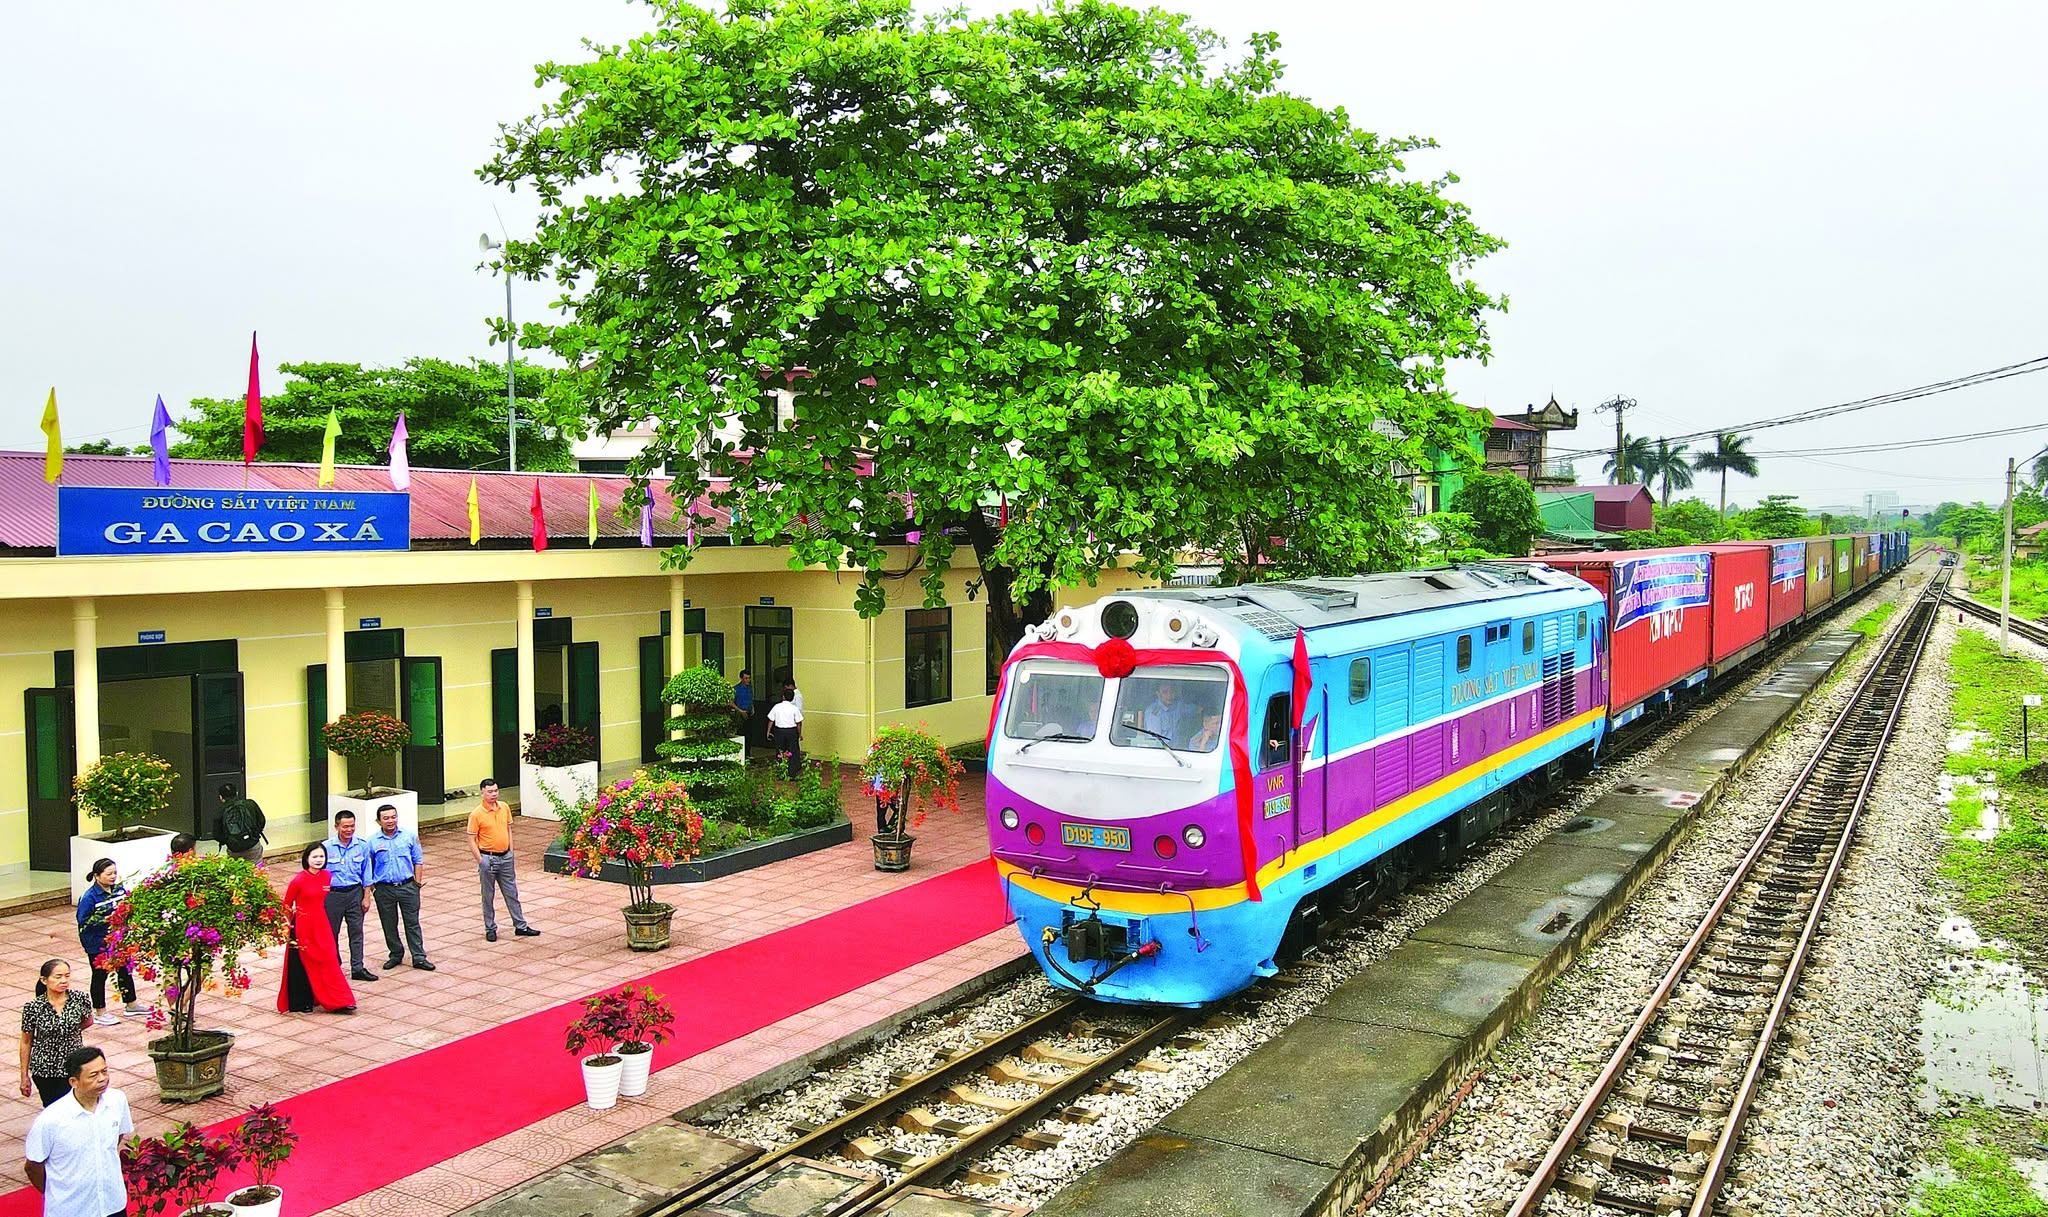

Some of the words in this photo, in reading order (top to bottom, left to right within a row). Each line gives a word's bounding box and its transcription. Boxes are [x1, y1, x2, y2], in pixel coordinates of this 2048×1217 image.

[142, 493, 215, 509] ĐƯỜNG
[221, 493, 260, 510] SẮT
[264, 495, 310, 512] VIỆT
[313, 499, 357, 511] NAM
[104, 522, 189, 543] GA
[198, 522, 306, 543] CAO
[312, 516, 384, 542] XÁ
[1522, 660, 1539, 681] NAM
[1267, 774, 1285, 792] VNR
[1065, 826, 1095, 845] D19E
[1103, 829, 1126, 847] 950
